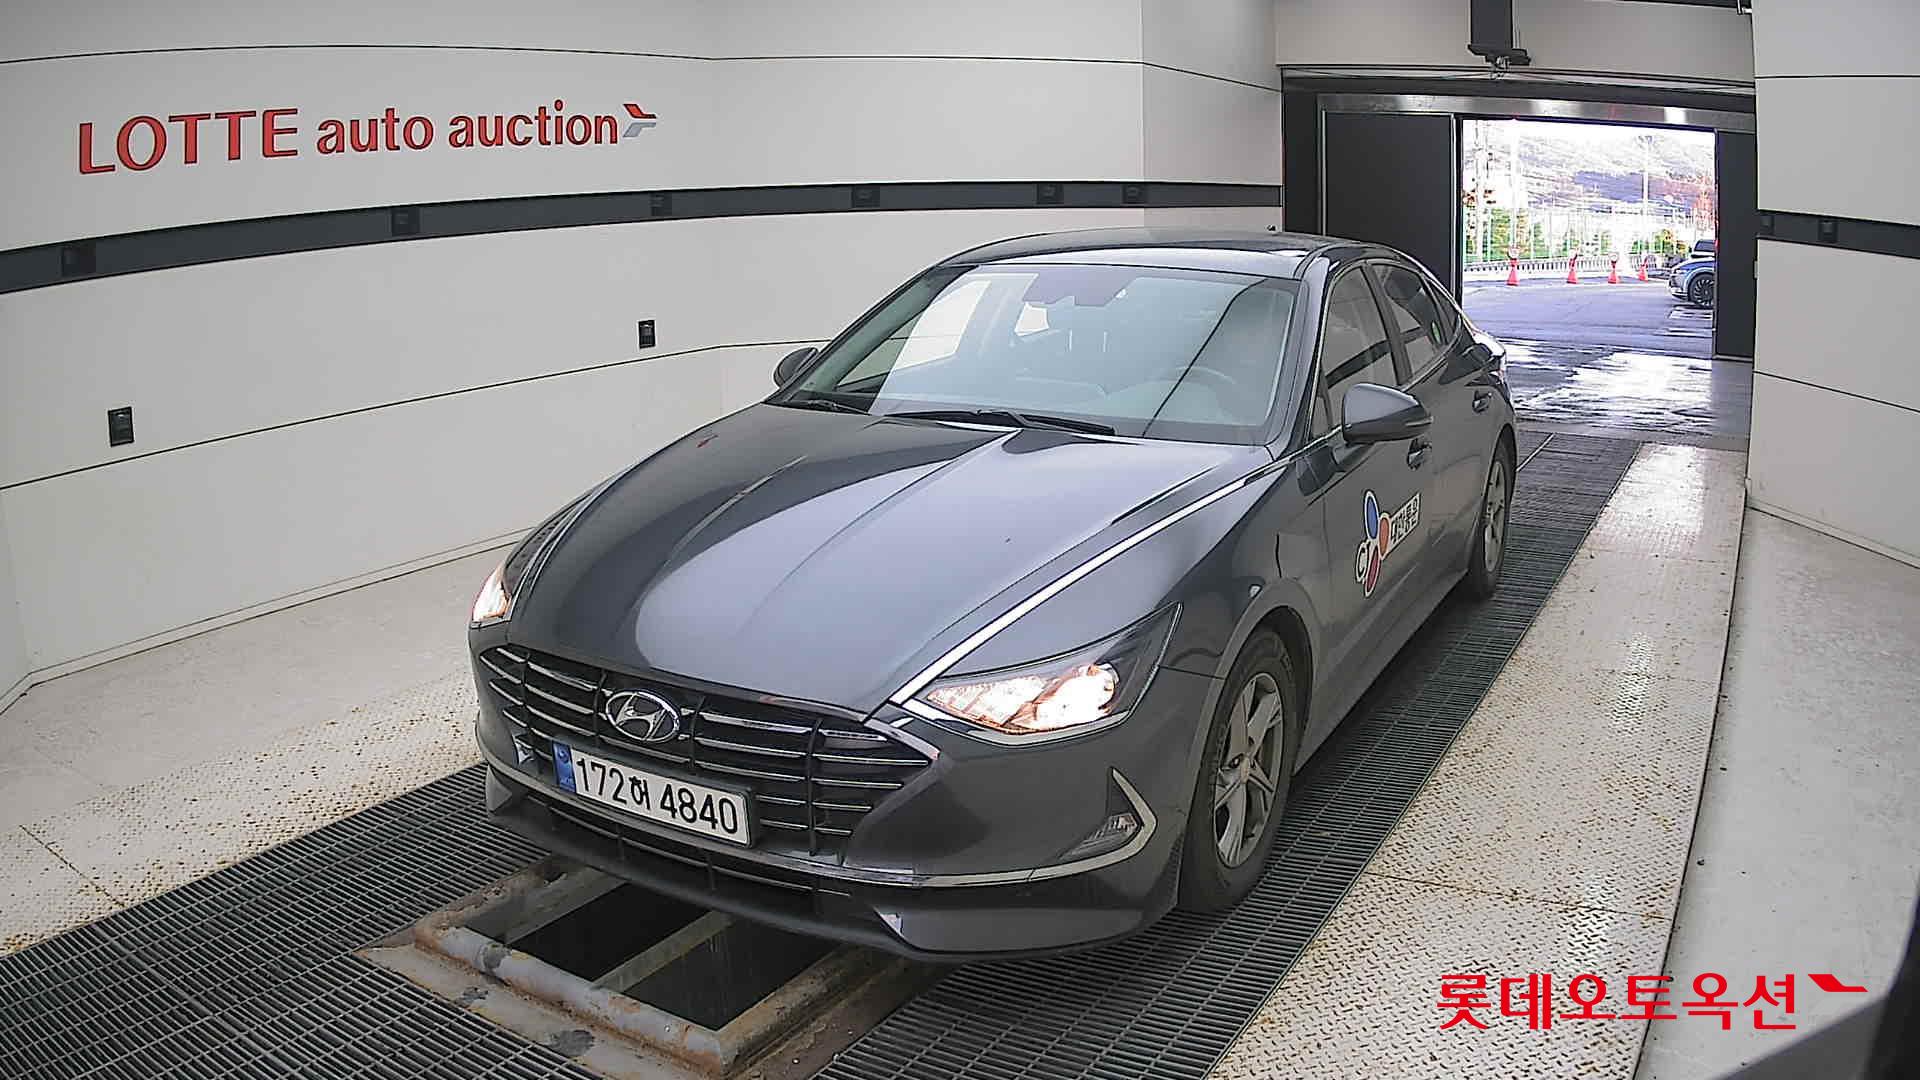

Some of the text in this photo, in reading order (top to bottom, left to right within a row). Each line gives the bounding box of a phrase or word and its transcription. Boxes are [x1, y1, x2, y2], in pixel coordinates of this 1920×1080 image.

[80, 99, 618, 174] LOTTE auto auction
[577, 757, 738, 834] 172허 4840
